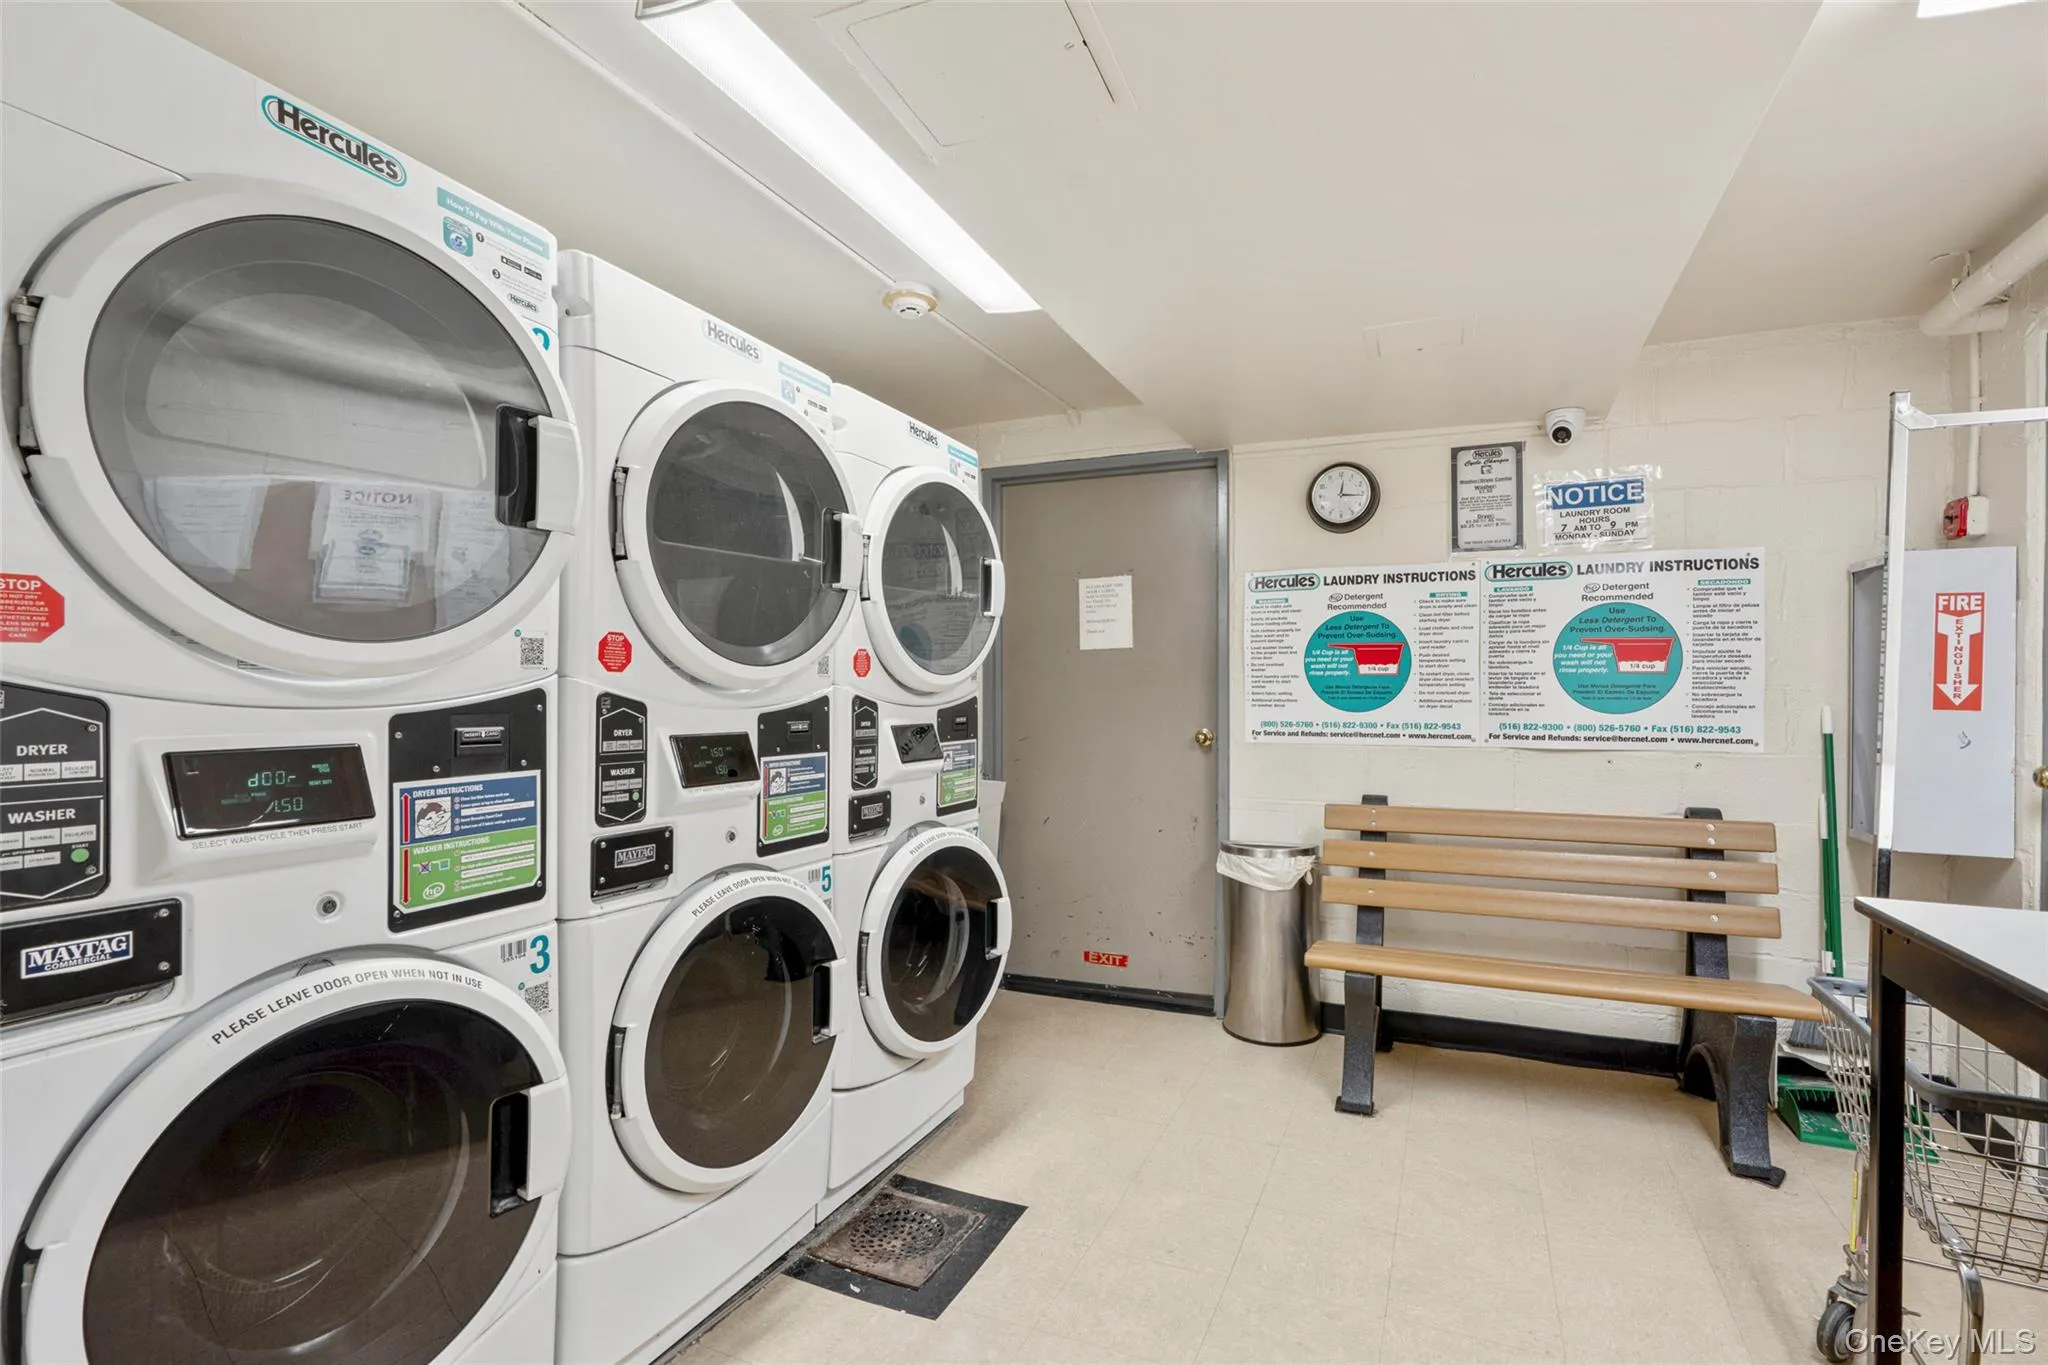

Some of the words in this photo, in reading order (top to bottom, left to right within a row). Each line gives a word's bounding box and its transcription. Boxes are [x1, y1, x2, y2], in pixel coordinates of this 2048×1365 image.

[277, 99, 399, 180] Hercules
[509, 294, 538, 312] Hercules
[706, 319, 760, 360] Hercules
[909, 421, 938, 446] Hercules
[1547, 483, 1643, 506] NOTICE
[1560, 509, 1601, 518] LAUNDRY
[1603, 506, 1631, 515] ROOM
[1561, 524, 1568, 532] 7
[1574, 524, 1587, 532] AM
[1610, 521, 1617, 529] 9
[1579, 516, 1611, 524] HOURS
[1555, 533, 1592, 541] MONDAY
[1600, 529, 1636, 538] SUNDAY
[1493, 563, 1567, 579] Hercules
[1577, 562, 1644, 576] LAUNDRY
[1649, 557, 1759, 573] INSTRUCTIONS
[1255, 575, 1315, 590] Hercules
[1323, 573, 1379, 586] LAUNDRY
[1383, 570, 1476, 584] INSTRUCTIONS
[1602, 582, 1650, 592] Detergent
[1344, 593, 1383, 602] Detergent
[1581, 592, 1654, 602] Recommended
[1938, 595, 1983, 611] FIRE
[1327, 602, 1387, 610] Recommended
[1602, 616, 1644, 624] Detergent
[1646, 615, 1657, 623] To
[1344, 623, 1379, 631] Detergent
[1574, 644, 1588, 652] Cup
[1953, 618, 1964, 700] EXTINGUISHER
[613, 729, 633, 737] DRYER
[1321, 721, 1341, 729] (516)
[1401, 722, 1422, 731] (516)
[1424, 722, 1461, 730] 822-9543
[1499, 722, 1521, 732] (516)
[1523, 722, 1564, 731] 822-9300
[1573, 723, 1597, 732] (800)
[1598, 724, 1641, 733] 526-5760
[1651, 725, 1667, 733] Fax
[1670, 725, 1694, 735] (516)
[1696, 725, 1742, 734] 822-9543
[1330, 731, 1401, 739] service@hercnet.com
[1502, 733, 1531, 741] Service
[1531, 733, 1547, 741] and
[1548, 734, 1582, 742] Refunds:
[1583, 735, 1668, 743] service@hercnet.com
[1677, 736, 1754, 745] www.hercnet.com
[16, 744, 68, 756] DRYER
[610, 767, 636, 777] WASHER
[412, 789, 436, 798] DRYER
[436, 784, 484, 795] INSTRUCTIONS
[7, 808, 76, 825] WASHER
[192, 838, 228, 850] SELECT
[230, 835, 257, 846] WASH
[258, 832, 287, 843] CYCLE
[287, 829, 310, 839] THEN
[311, 825, 338, 836] PRESS
[339, 822, 363, 832] START
[413, 845, 443, 855] WASHER
[444, 836, 490, 850] INSTRUCTIONS
[617, 846, 653, 863] MAYTAG
[821, 865, 832, 892] 5
[691, 896, 716, 918] PLEASE
[714, 886, 733, 900] LEAVE
[733, 878, 750, 890] DOOR
[750, 875, 766, 884] OPEN
[28, 936, 128, 968] MAYTAG
[529, 934, 550, 974] 3
[1089, 952, 1123, 966] EXIT
[43, 954, 112, 972] COMMERCIAL
[211, 1007, 268, 1045] PLEASE
[267, 987, 312, 1013] LEAVE
[313, 975, 352, 995] DOOR
[355, 969, 389, 983] OPEN
[391, 968, 426, 979] WHEN
[428, 970, 449, 980] NOT
[452, 972, 462, 983] IN
[464, 977, 483, 990] USE
